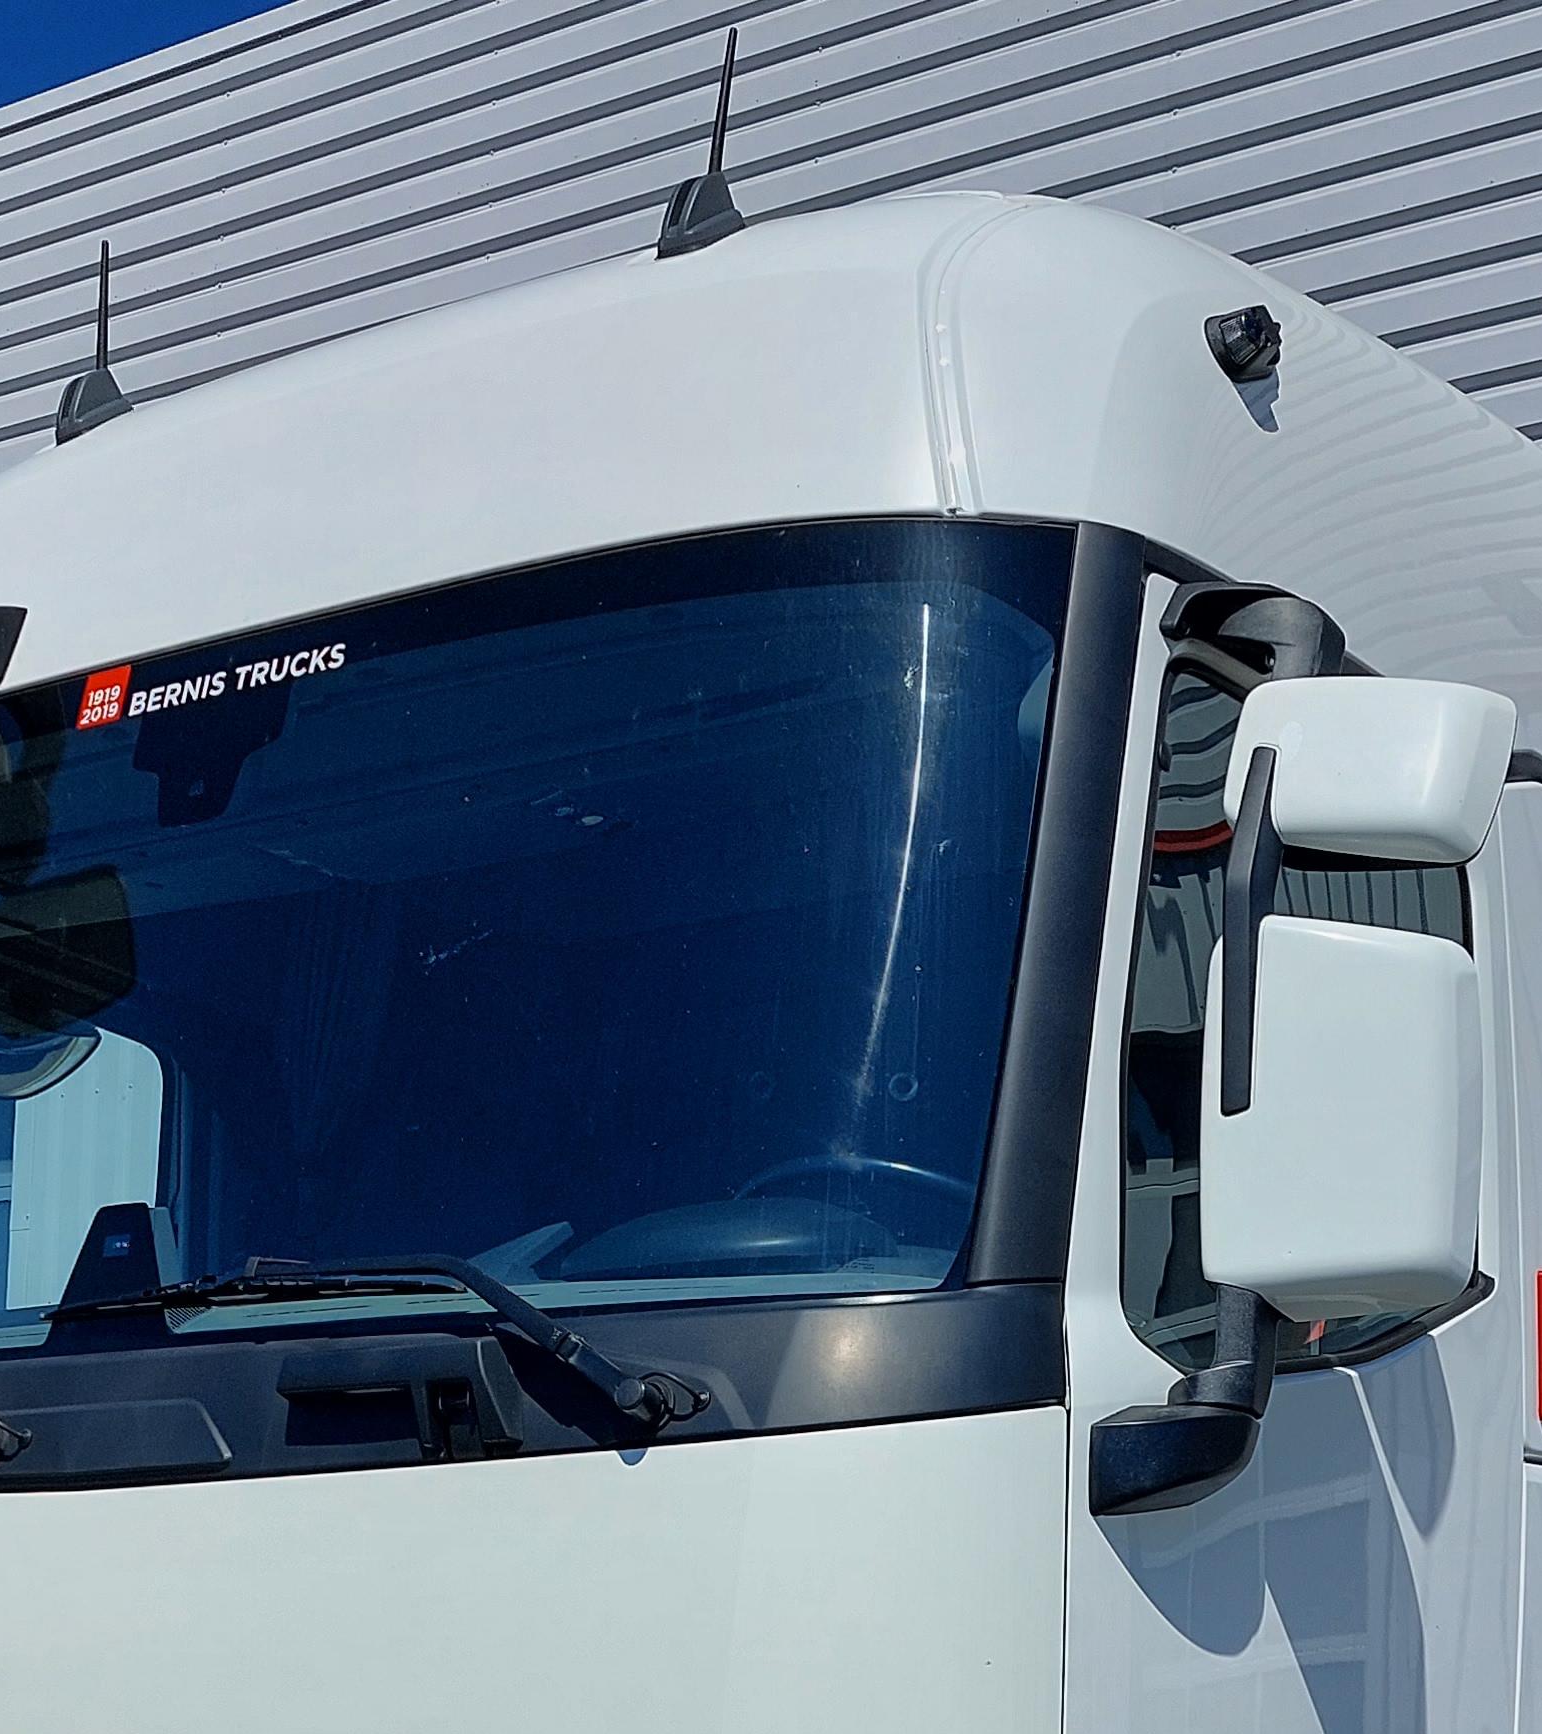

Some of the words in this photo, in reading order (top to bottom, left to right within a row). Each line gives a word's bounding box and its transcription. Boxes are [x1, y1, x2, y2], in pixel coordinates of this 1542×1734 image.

[127, 671, 228, 718] BERNIS
[235, 643, 347, 692] TRUCKS
[87, 684, 122, 707] 1919
[79, 701, 120, 726] 2019
